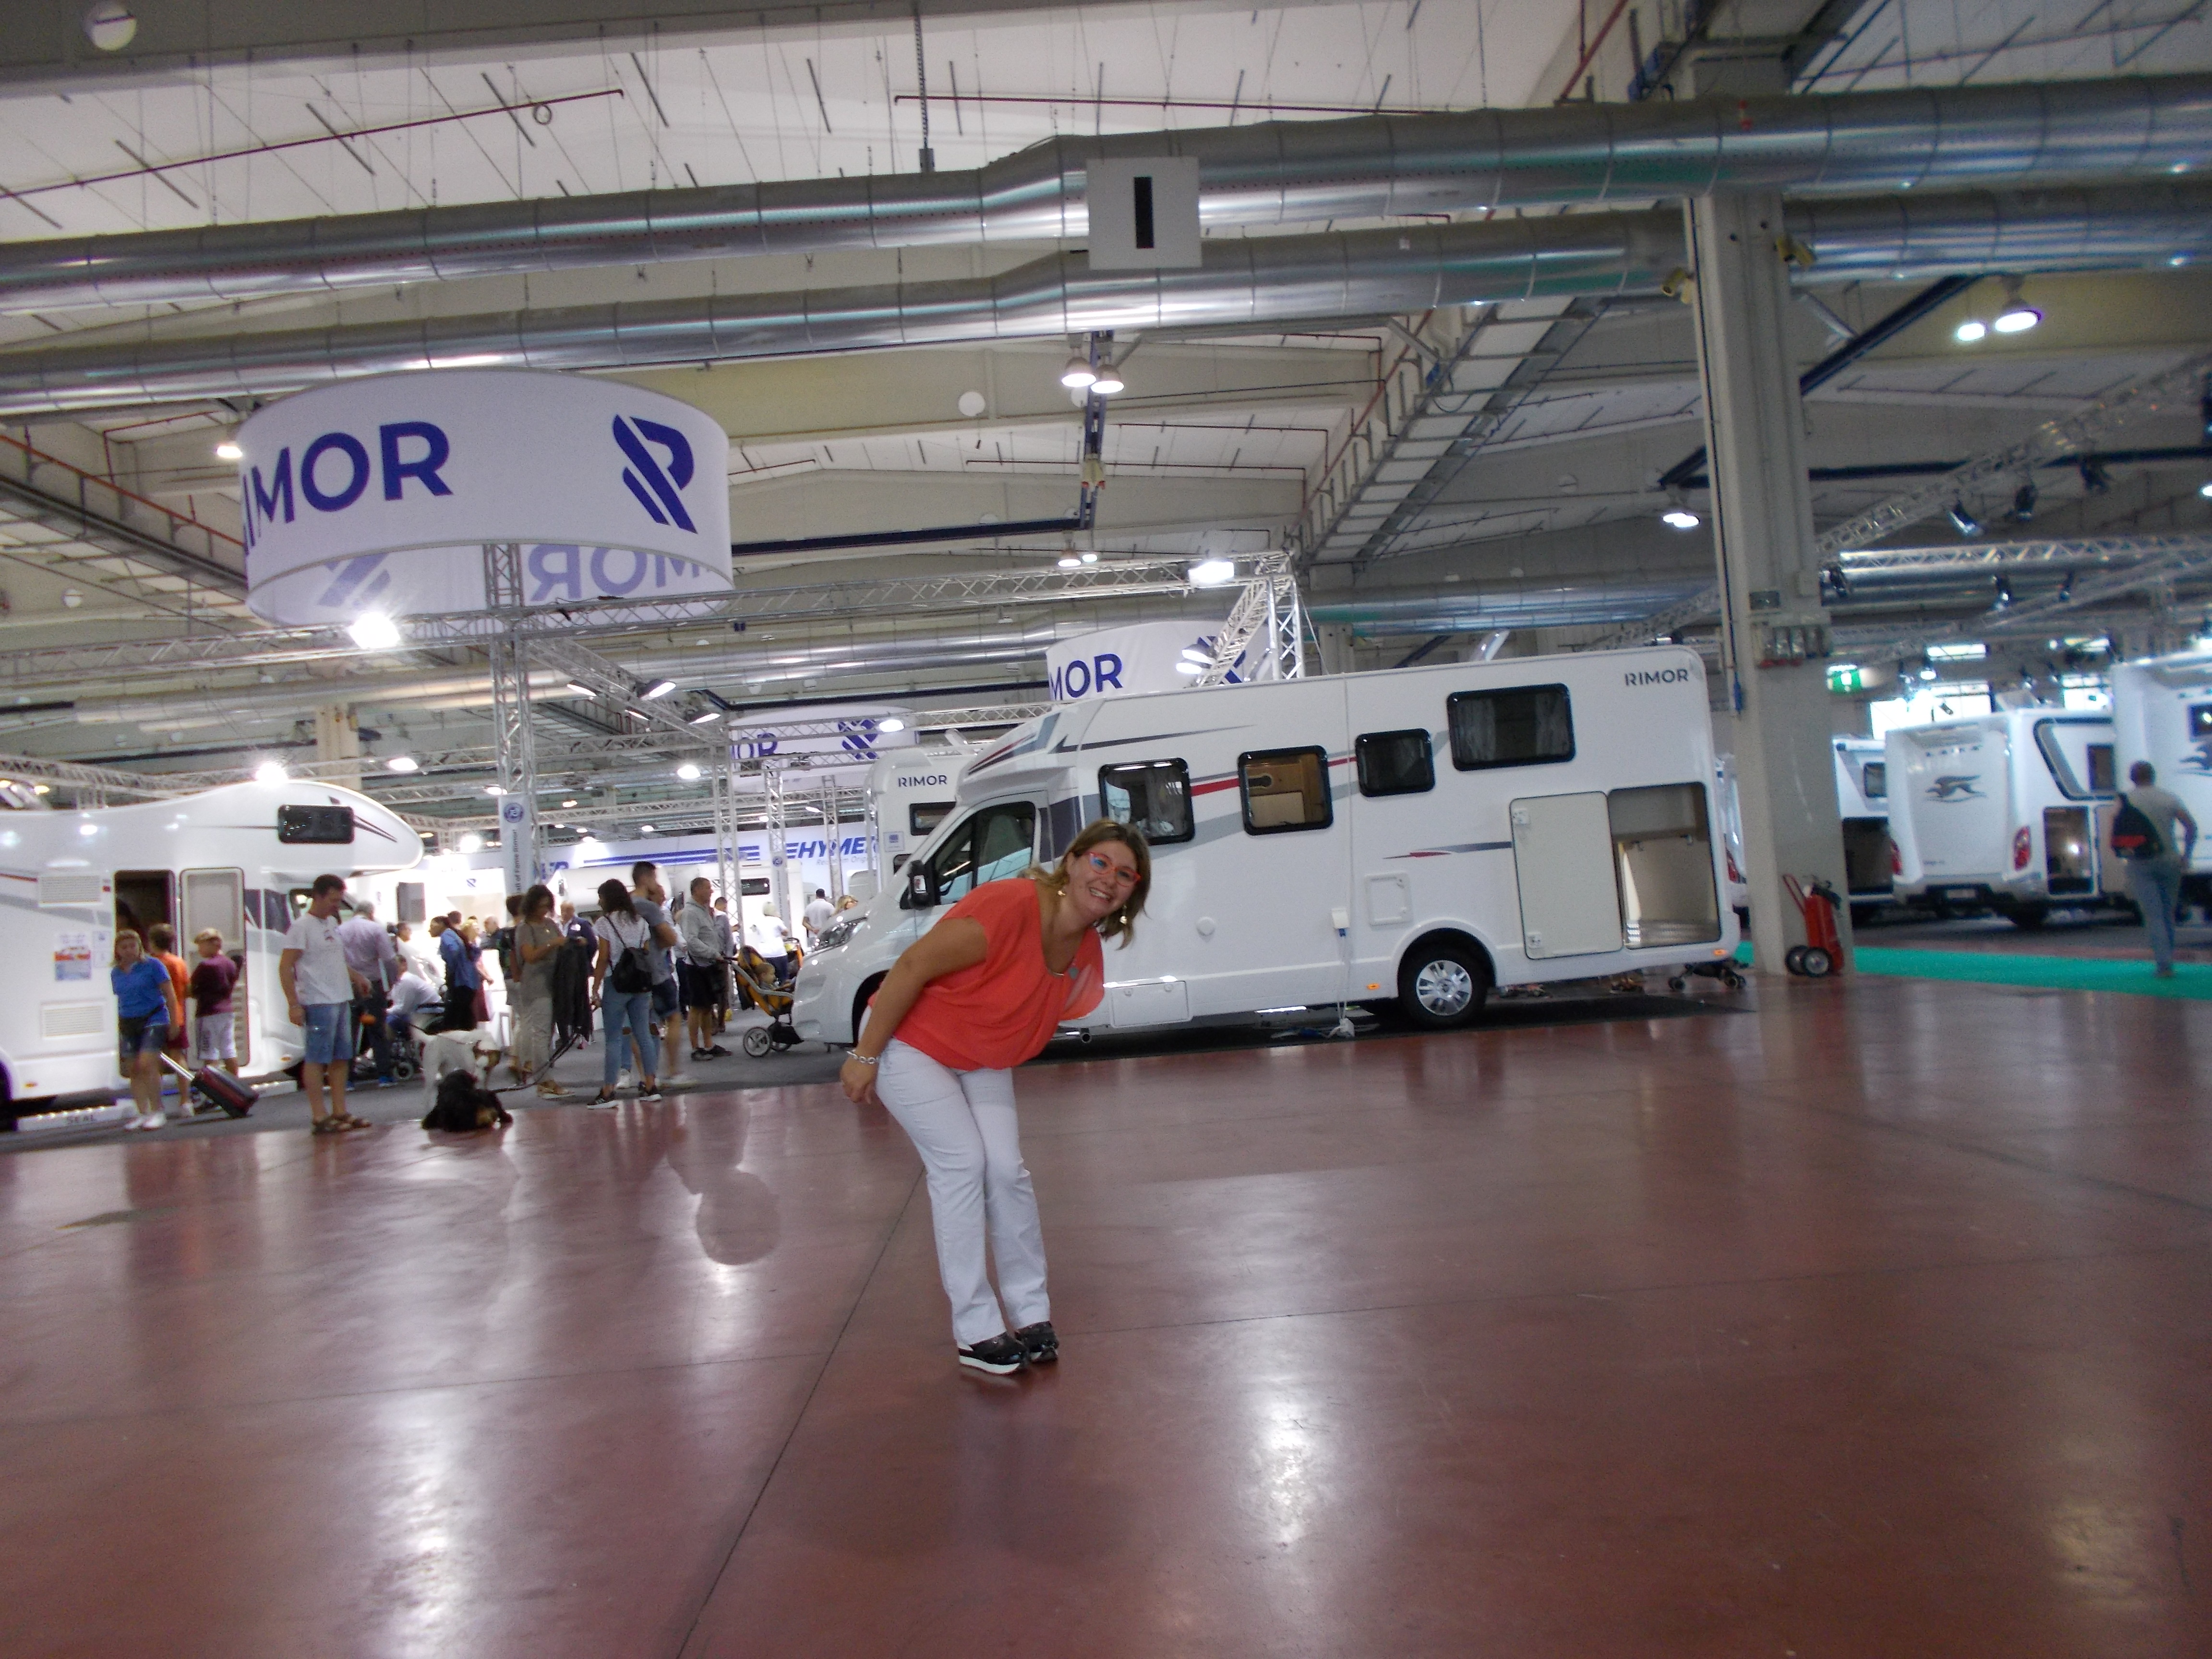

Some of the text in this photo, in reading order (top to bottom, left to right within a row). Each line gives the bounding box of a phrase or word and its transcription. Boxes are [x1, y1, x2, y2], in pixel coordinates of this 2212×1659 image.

[243, 421, 454, 556] IMOR
[1624, 668, 1689, 686] RIMOR
[898, 774, 948, 788] RIMOR
[797, 836, 877, 858] HYME
